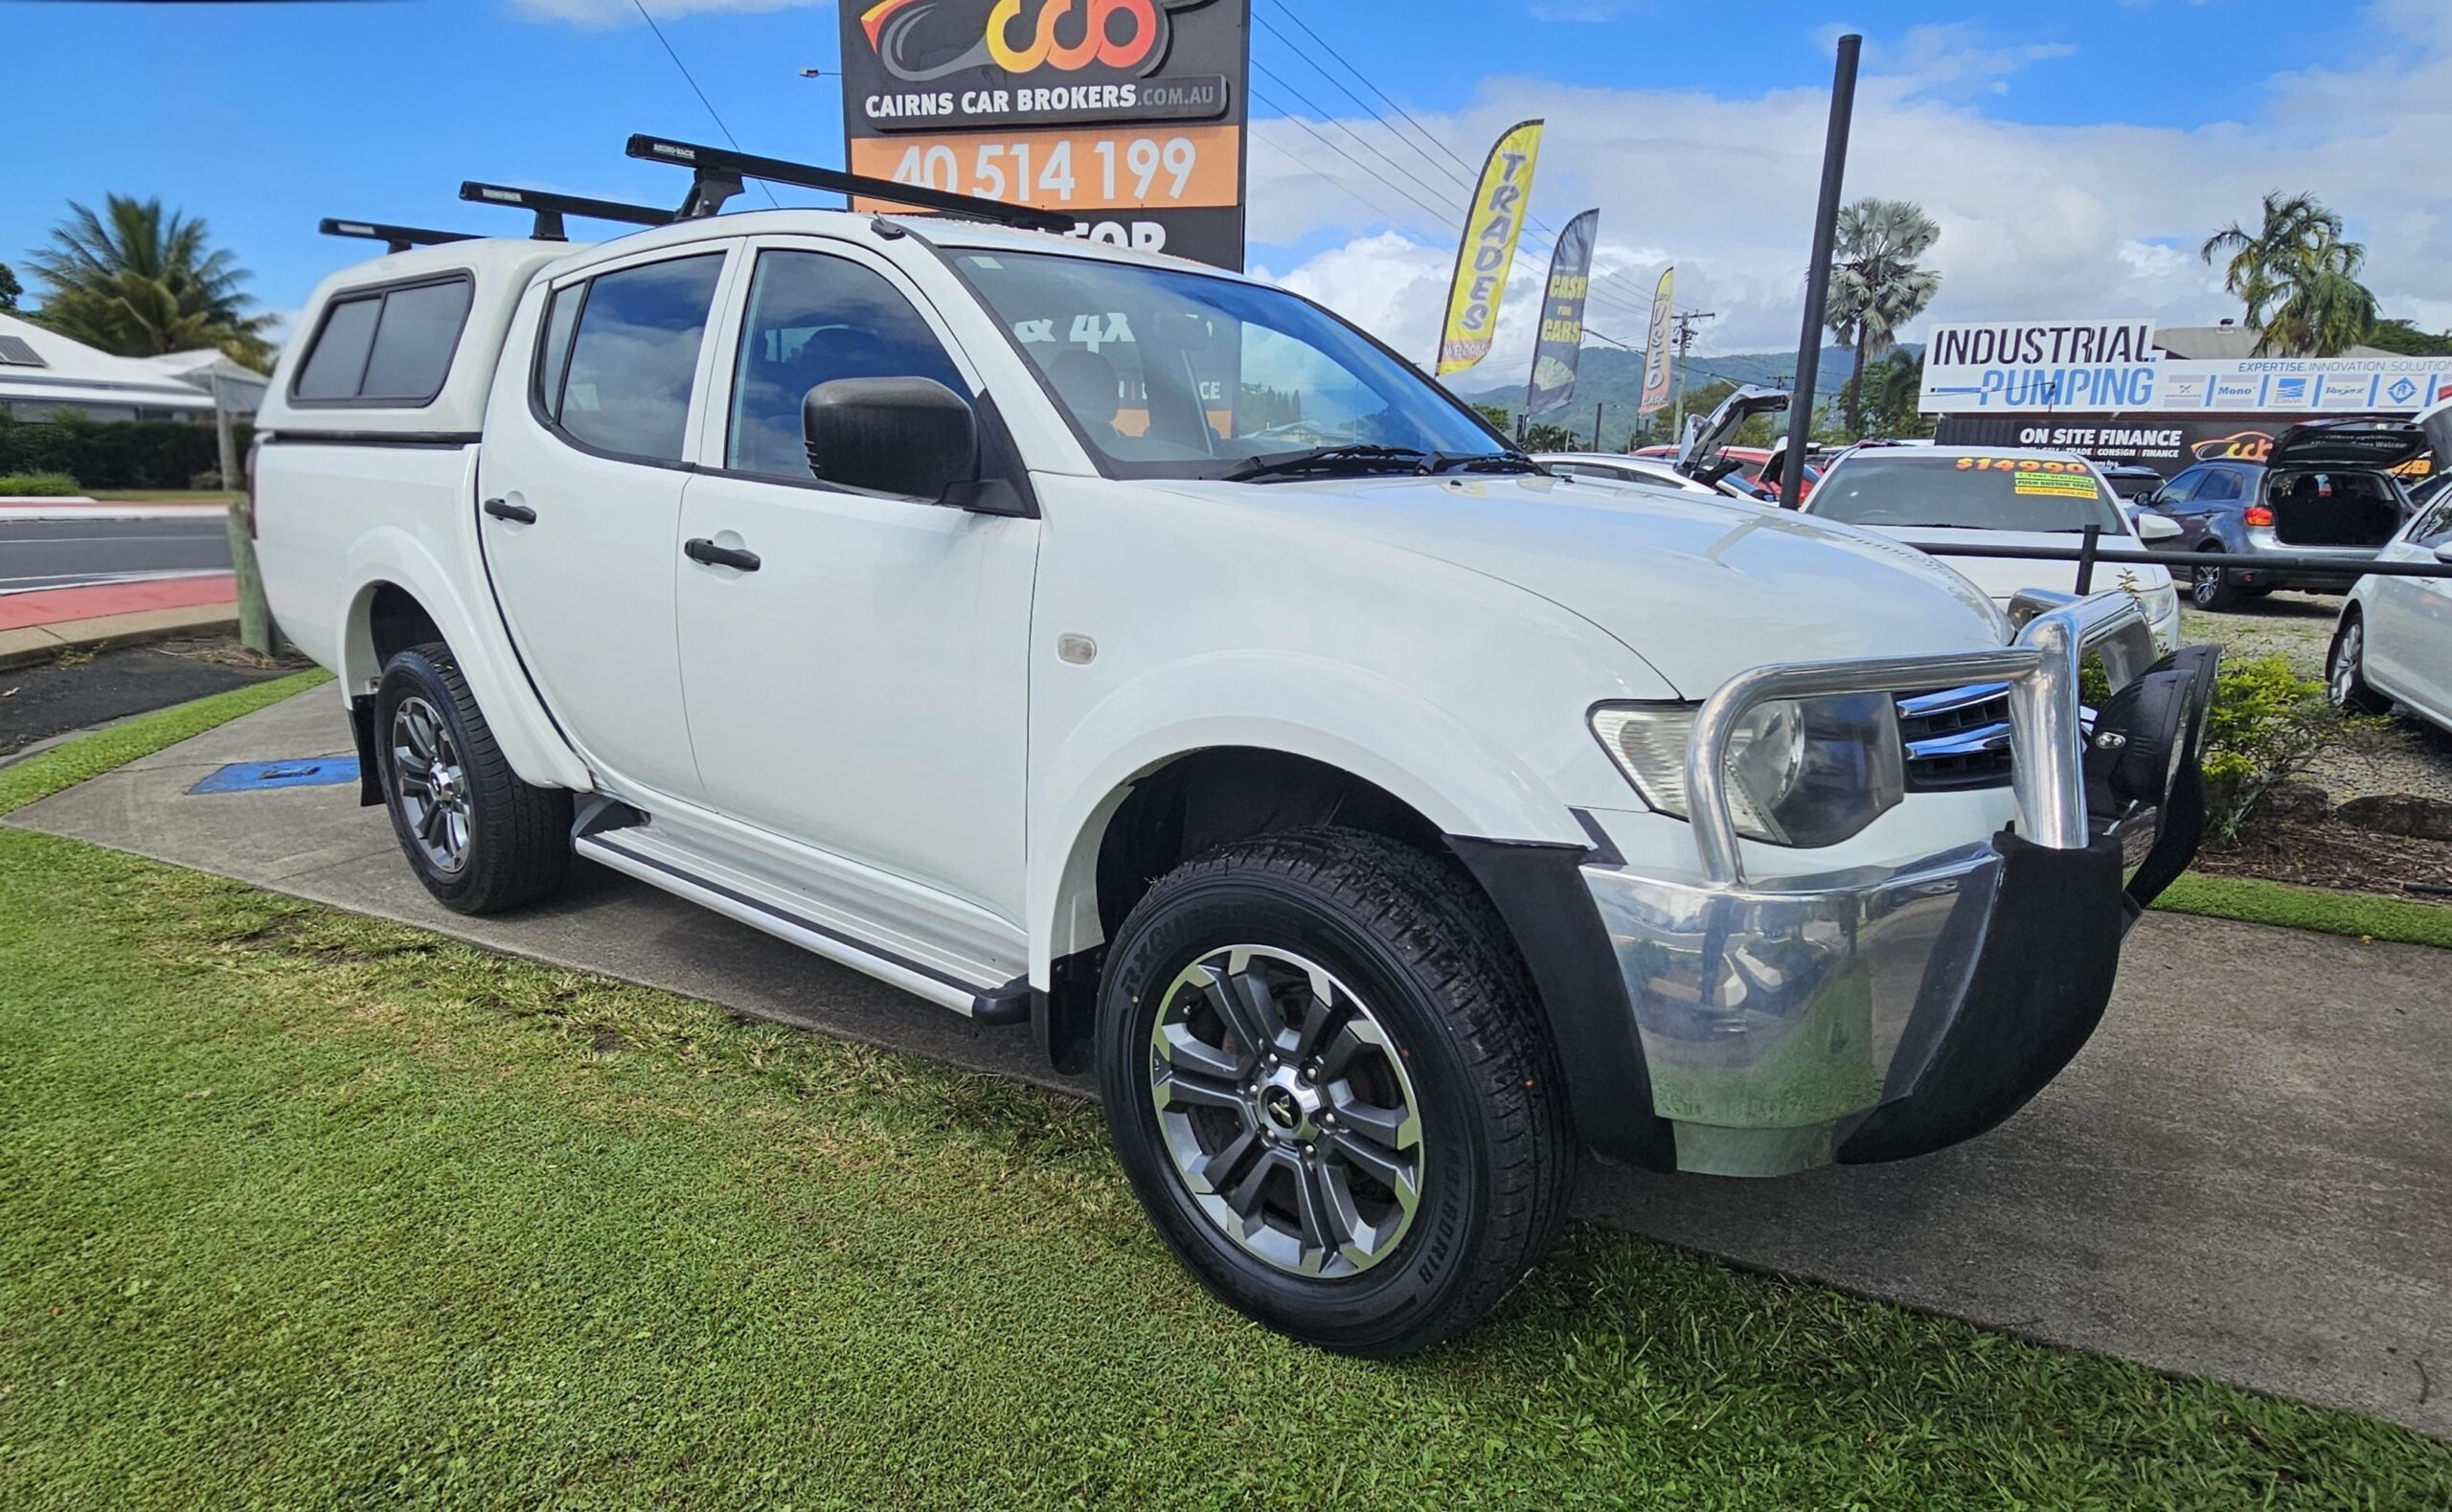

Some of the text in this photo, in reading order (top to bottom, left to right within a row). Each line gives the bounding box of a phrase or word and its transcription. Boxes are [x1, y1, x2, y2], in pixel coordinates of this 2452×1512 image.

[865, 93, 954, 119] CAIRNS
[961, 90, 1010, 115] CAR
[892, 137, 1196, 202] 40 514 199
[1462, 151, 1527, 330] TRADES
[1646, 305, 1667, 391] USED
[1933, 325, 2149, 366] INDUSTRIAL
[1979, 367, 2155, 407] PUMPING
[2217, 386, 2252, 395] Mono
[2020, 428, 2183, 447] ON SITE FINANCE
[2097, 448, 2136, 457] CONSIGN
[2142, 449, 2180, 458] FINANCE
[1956, 457, 2088, 474] $14990
